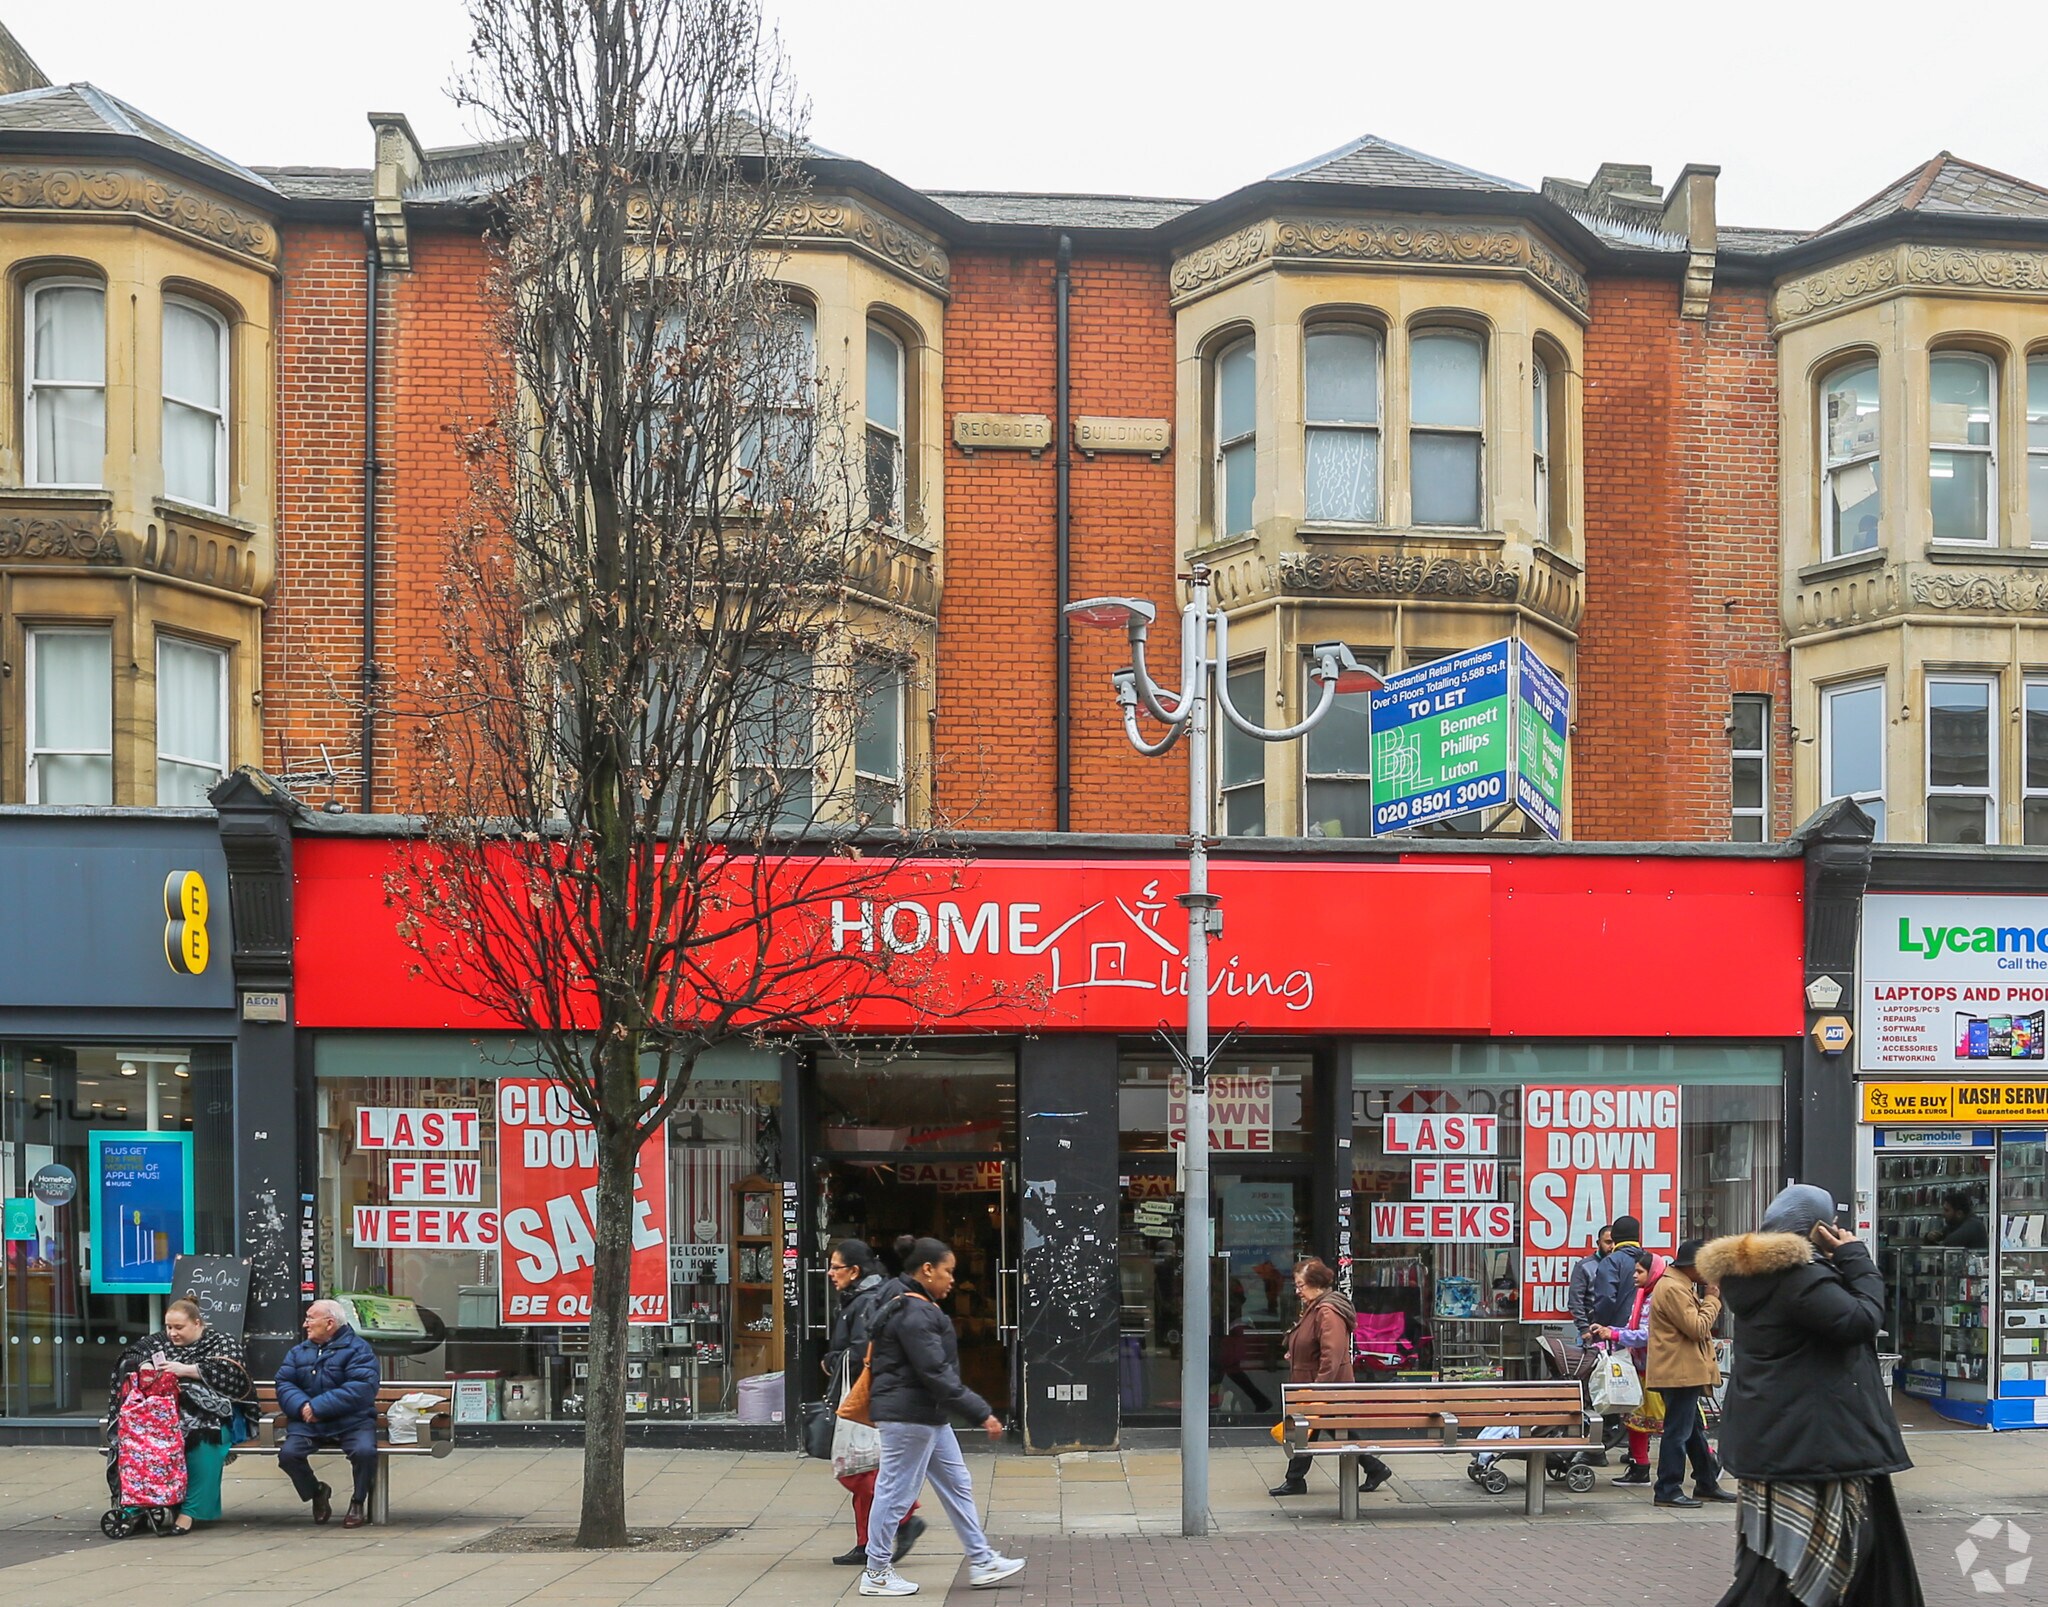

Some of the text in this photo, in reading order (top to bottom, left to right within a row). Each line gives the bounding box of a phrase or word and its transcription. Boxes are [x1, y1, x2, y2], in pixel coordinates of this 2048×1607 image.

[960, 422, 1044, 438] RECORDER
[1082, 425, 1163, 441] BUILDINGS
[1383, 651, 1492, 693] Substantial Retail Premises
[1372, 660, 1506, 710] Over 3 Floors Totalling 5,588 sq.ft
[1408, 688, 1466, 719] TO LET
[1533, 690, 1554, 724] TO LET
[1440, 706, 1498, 737] Bennett
[1440, 732, 1490, 759] Phillips
[1440, 760, 1478, 782] Luton
[1377, 777, 1501, 825] 020 8501 3000
[831, 900, 1042, 954] HOME
[1997, 957, 2048, 970] Call the
[245, 997, 278, 1006] AEON
[1874, 986, 2048, 1002] LAPTOPS AND PHO
[1826, 1028, 1845, 1038] ADT
[1895, 1097, 1948, 1107] WE BUY
[1959, 1088, 2001, 1104] KASH
[1527, 1089, 1676, 1129] CLOSING
[360, 1111, 477, 1147] LAST
[1386, 1117, 1496, 1151] LAST
[1895, 1131, 1962, 1143] Lycamobile
[105, 1146, 148, 1155] PLUS GET
[523, 1128, 640, 1169] DOW
[1547, 1131, 1656, 1170] DOWN
[105, 1171, 135, 1180] APPLE
[145, 1163, 159, 1171] OF
[898, 1164, 975, 1182] SALE
[1414, 1162, 1495, 1194] FEW
[38, 1176, 72, 1184] HomePod
[392, 1162, 477, 1196] FEW
[357, 1209, 499, 1244] WEEKS
[1374, 1206, 1511, 1237] WEEKS
[670, 1246, 717, 1257] WELCOME
[670, 1259, 683, 1269] TO
[509, 1295, 550, 1316] BE
[557, 1295, 665, 1317] QUK!!
